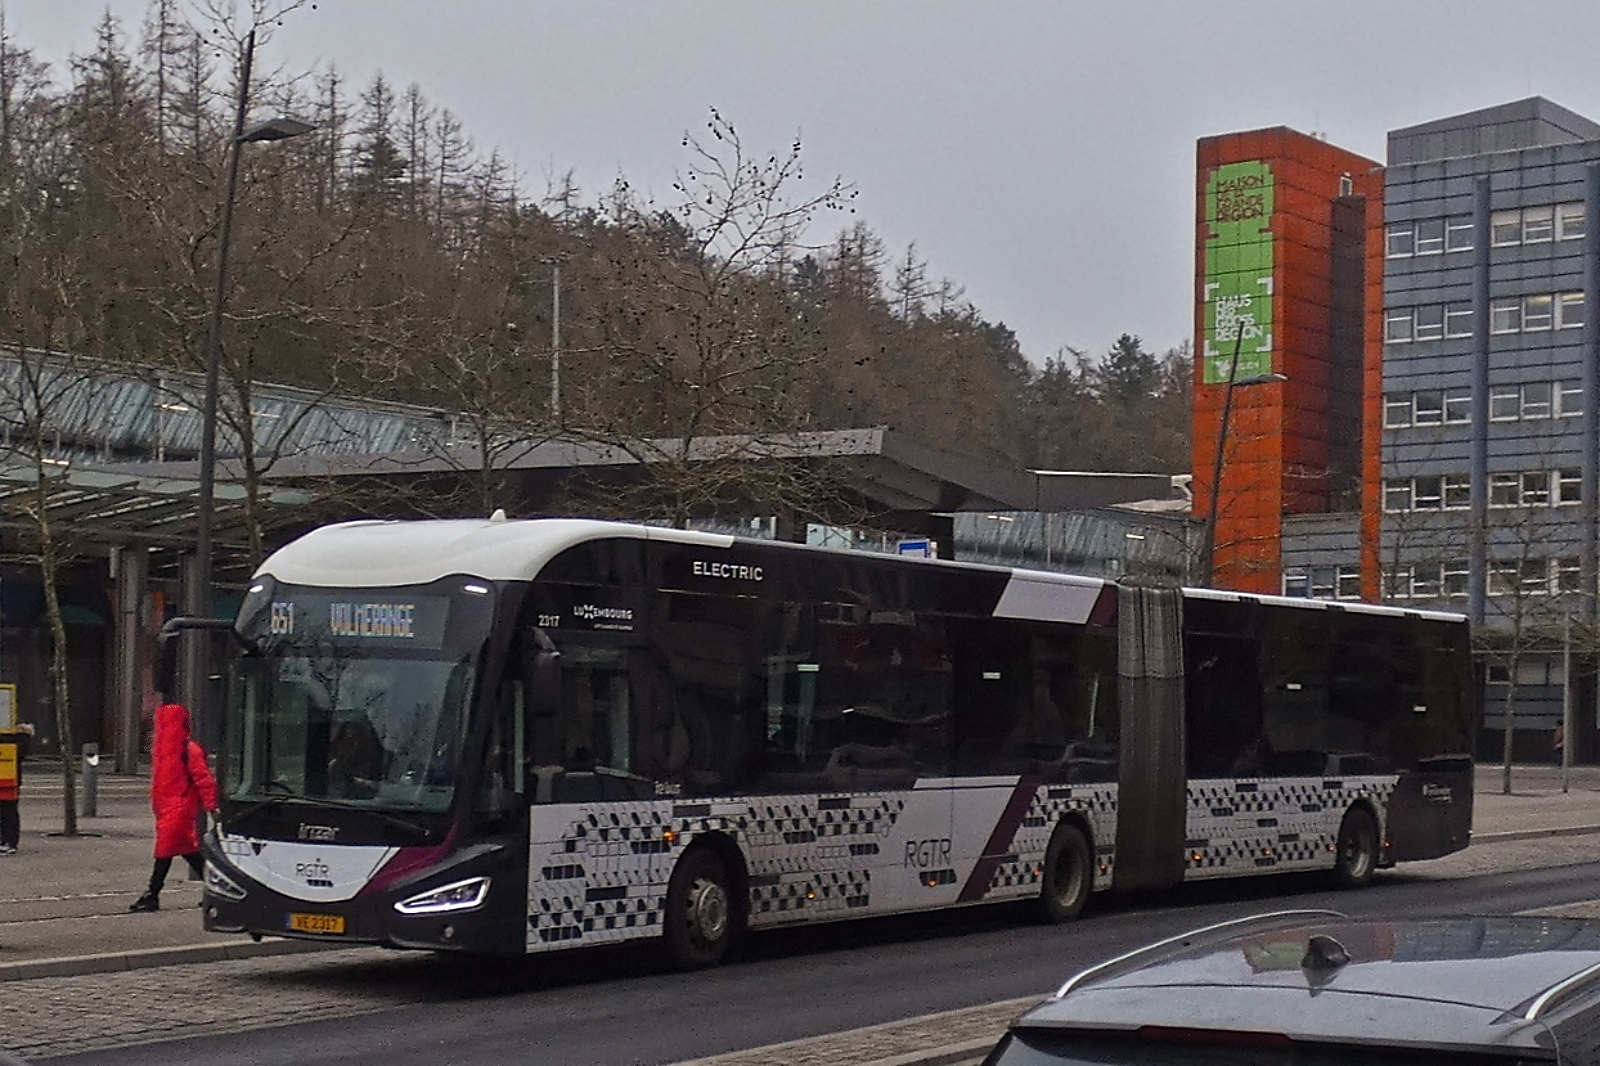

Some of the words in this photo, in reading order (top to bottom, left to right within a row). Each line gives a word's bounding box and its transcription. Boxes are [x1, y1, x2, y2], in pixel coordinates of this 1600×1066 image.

[693, 561, 763, 581] ELECTRIC
[270, 602, 294, 635] 651
[538, 614, 560, 627] 2317
[573, 604, 633, 620] LUXEMBOURG
[904, 838, 952, 868] RGTR
[296, 862, 329, 878] RGTR
